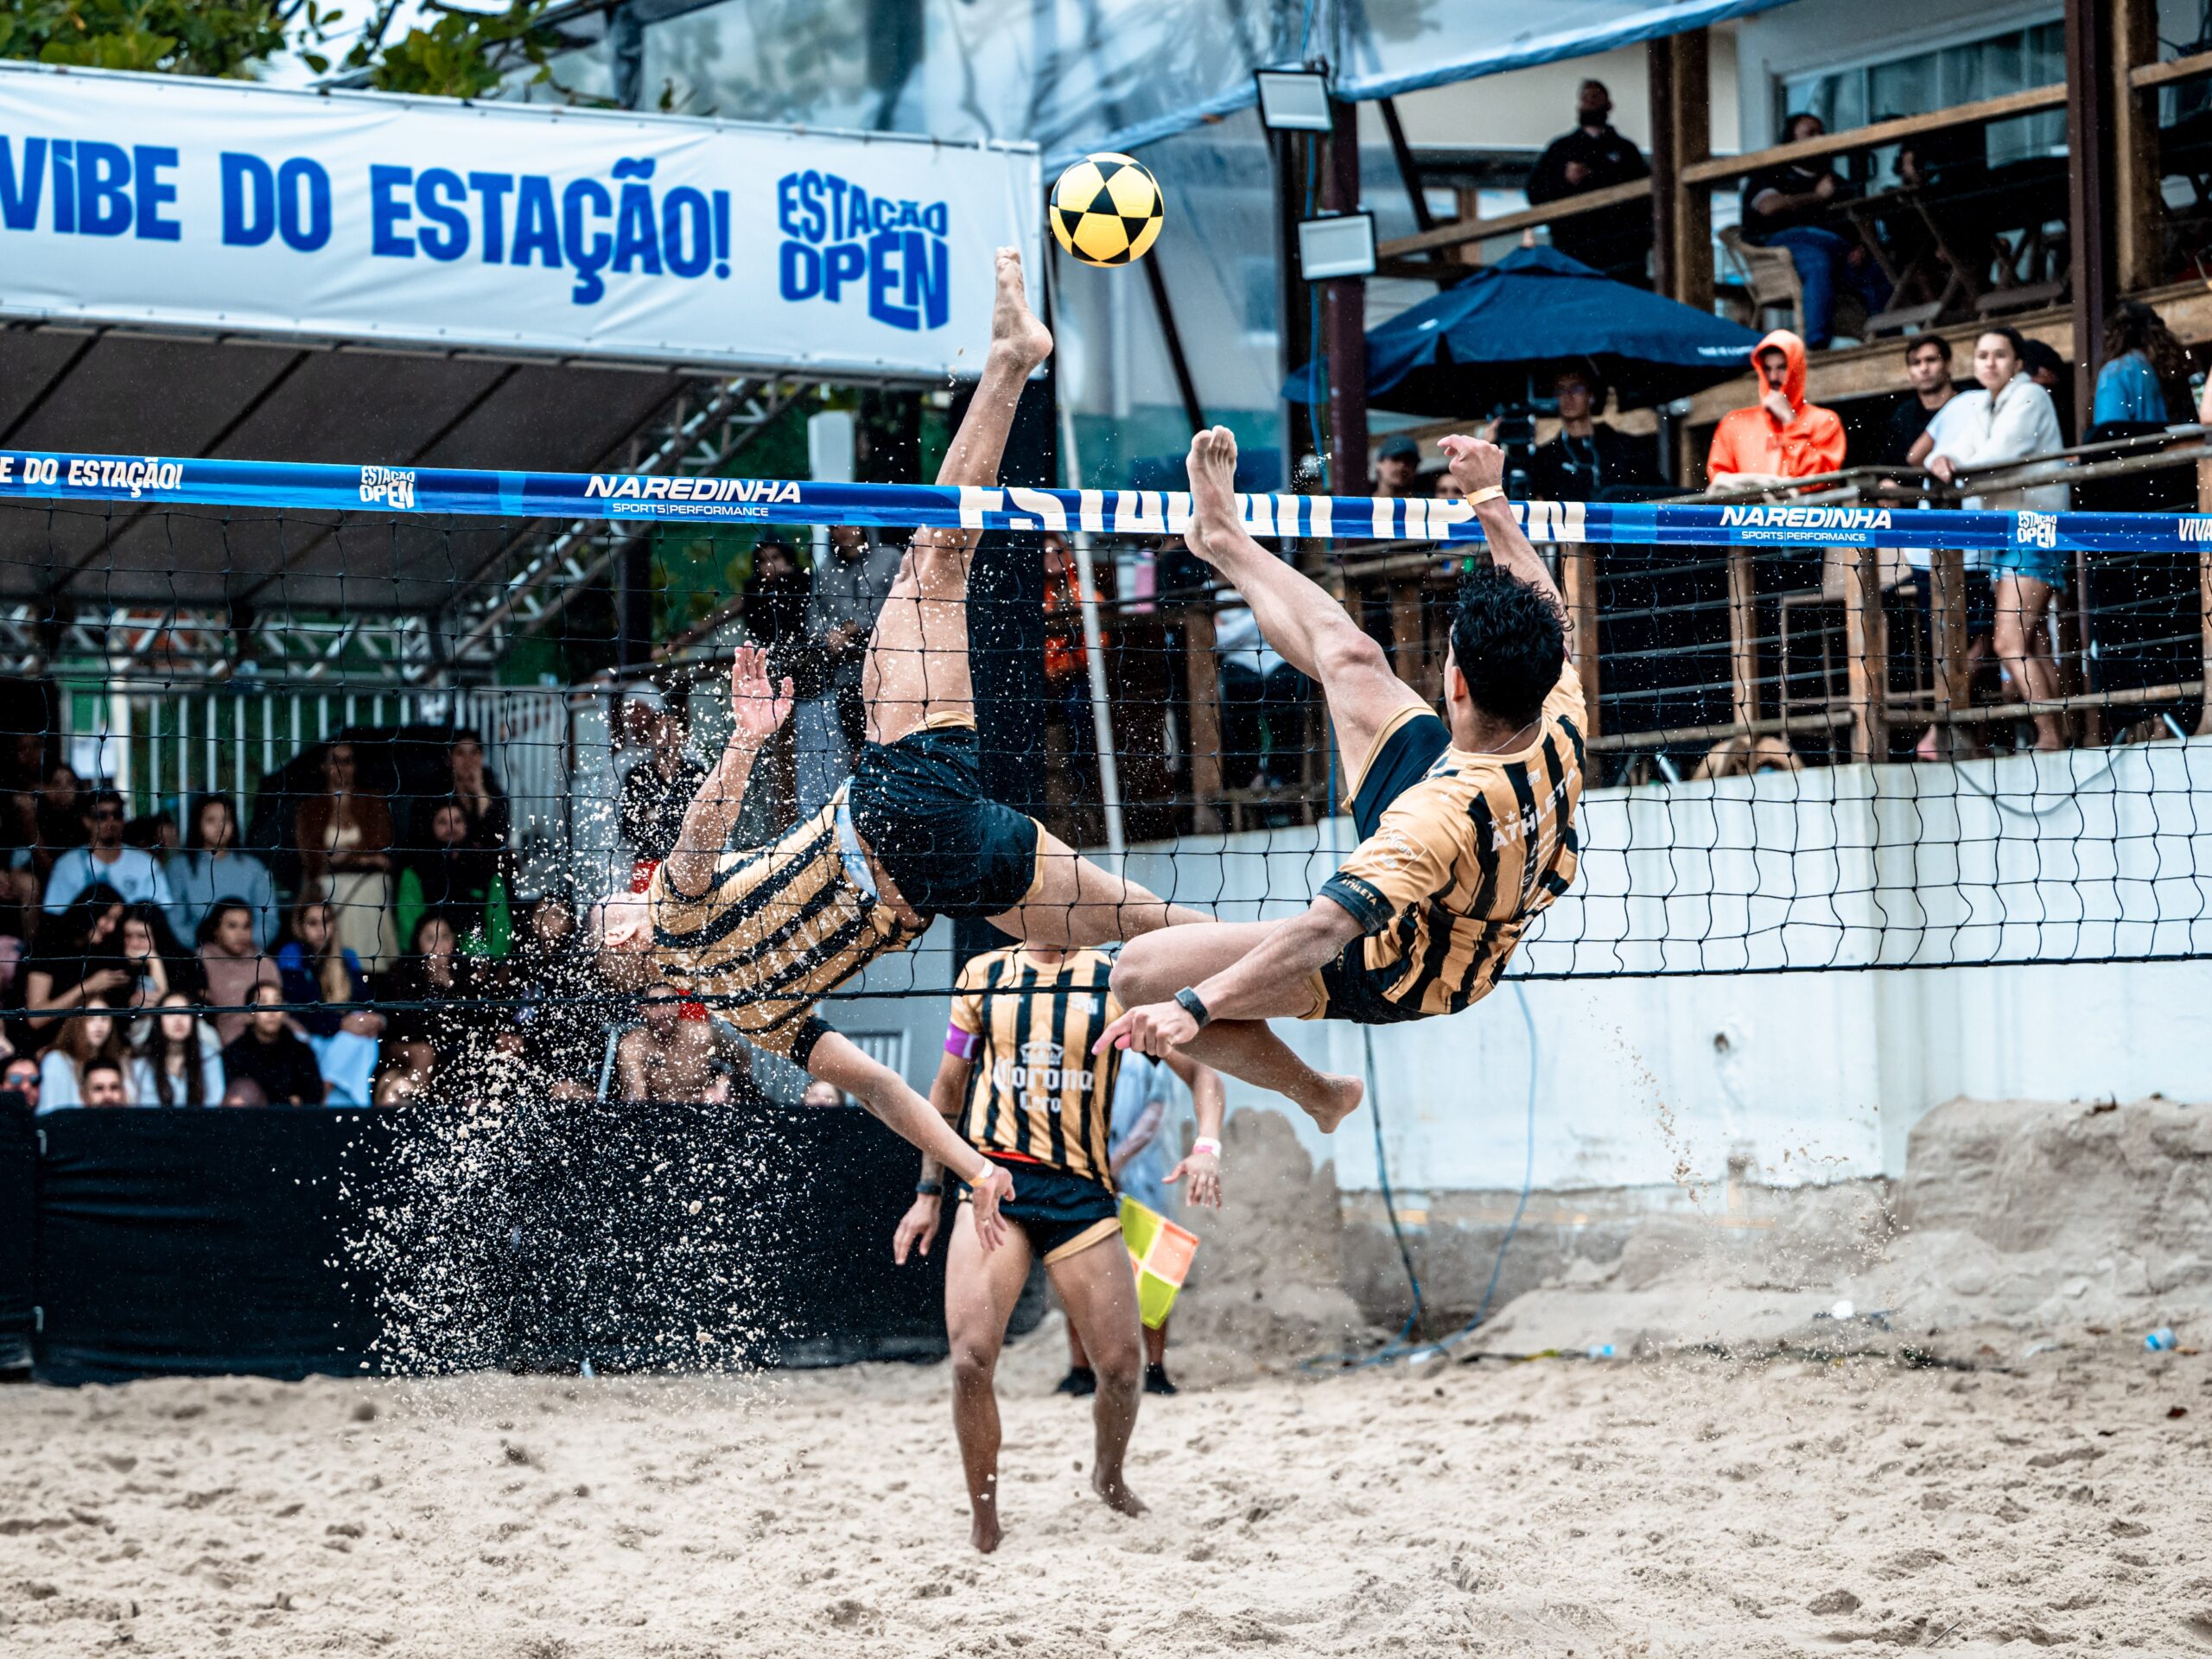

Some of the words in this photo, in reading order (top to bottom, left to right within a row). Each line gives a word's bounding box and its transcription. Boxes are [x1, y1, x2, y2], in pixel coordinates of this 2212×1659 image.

[777, 169, 949, 244] ESTAÇÃO
[219, 151, 333, 253] DO
[369, 156, 732, 306] ESTAÇÃO!
[779, 230, 950, 332] OPEN
[22, 457, 60, 485] DO
[67, 456, 184, 499] ESTAÇÃO!
[359, 480, 415, 509] OPEN
[584, 475, 801, 503] NAREDINHA
[1719, 505, 1892, 530] NAREDINHA
[2017, 522, 2057, 549] OPEN
[1340, 878, 1378, 906] ATHLETA
[992, 1054, 1095, 1096] Corona
